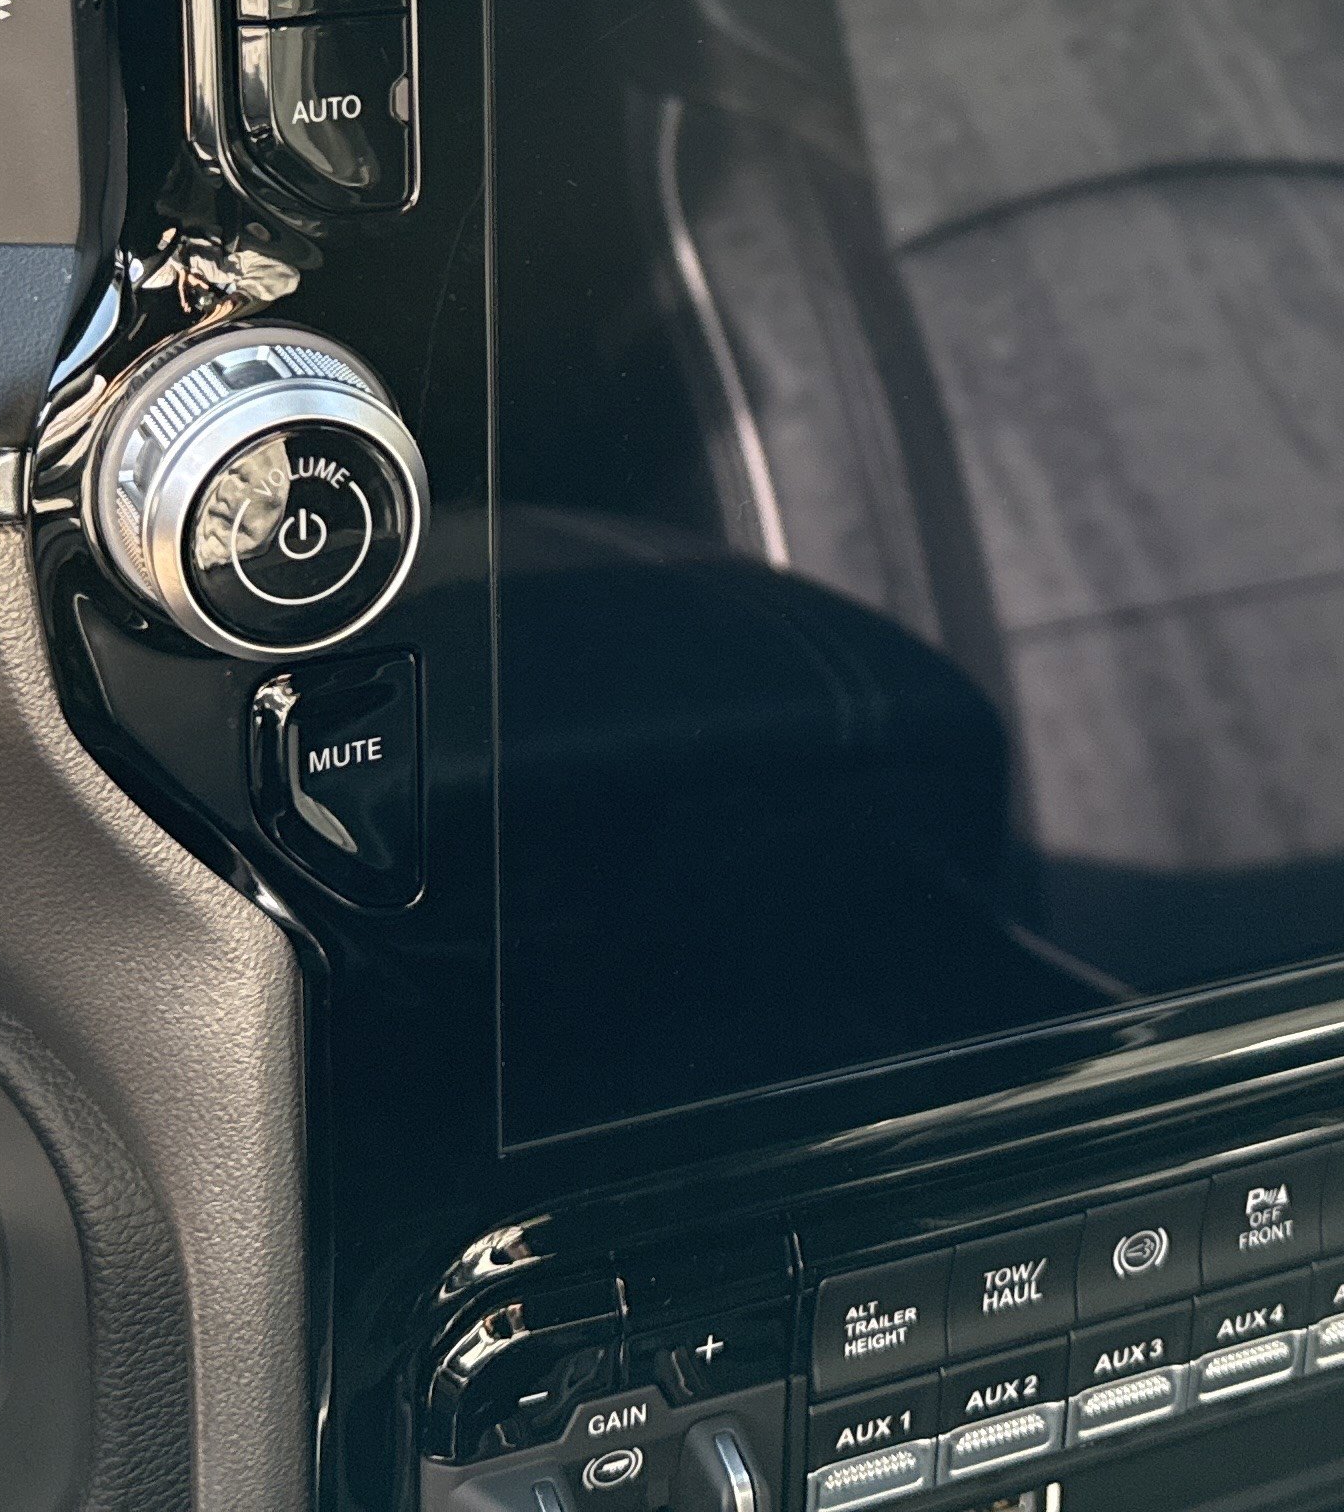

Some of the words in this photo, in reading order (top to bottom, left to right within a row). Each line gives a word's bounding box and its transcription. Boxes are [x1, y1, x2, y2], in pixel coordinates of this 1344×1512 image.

[292, 96, 362, 123] AUTO
[256, 456, 351, 500] VOLUME
[308, 736, 383, 774] MUTE
[1238, 1219, 1294, 1251] FRONT
[1248, 1207, 1282, 1230] OFF
[983, 1257, 1049, 1291] TOW/
[844, 1300, 879, 1322] ALT
[982, 1280, 1043, 1313] HAUL
[843, 1305, 918, 1340] TRAILER
[1216, 1308, 1266, 1341] AUX
[1267, 1303, 1285, 1325] 4
[843, 1326, 909, 1358] HEIGHT
[1092, 1341, 1144, 1377] AUX
[1146, 1337, 1164, 1359] 3
[964, 1381, 1019, 1414] AUX
[1023, 1375, 1040, 1397] 2
[587, 1402, 648, 1437] GAIN
[834, 1414, 892, 1451] AUX
[898, 1409, 912, 1433] 1
